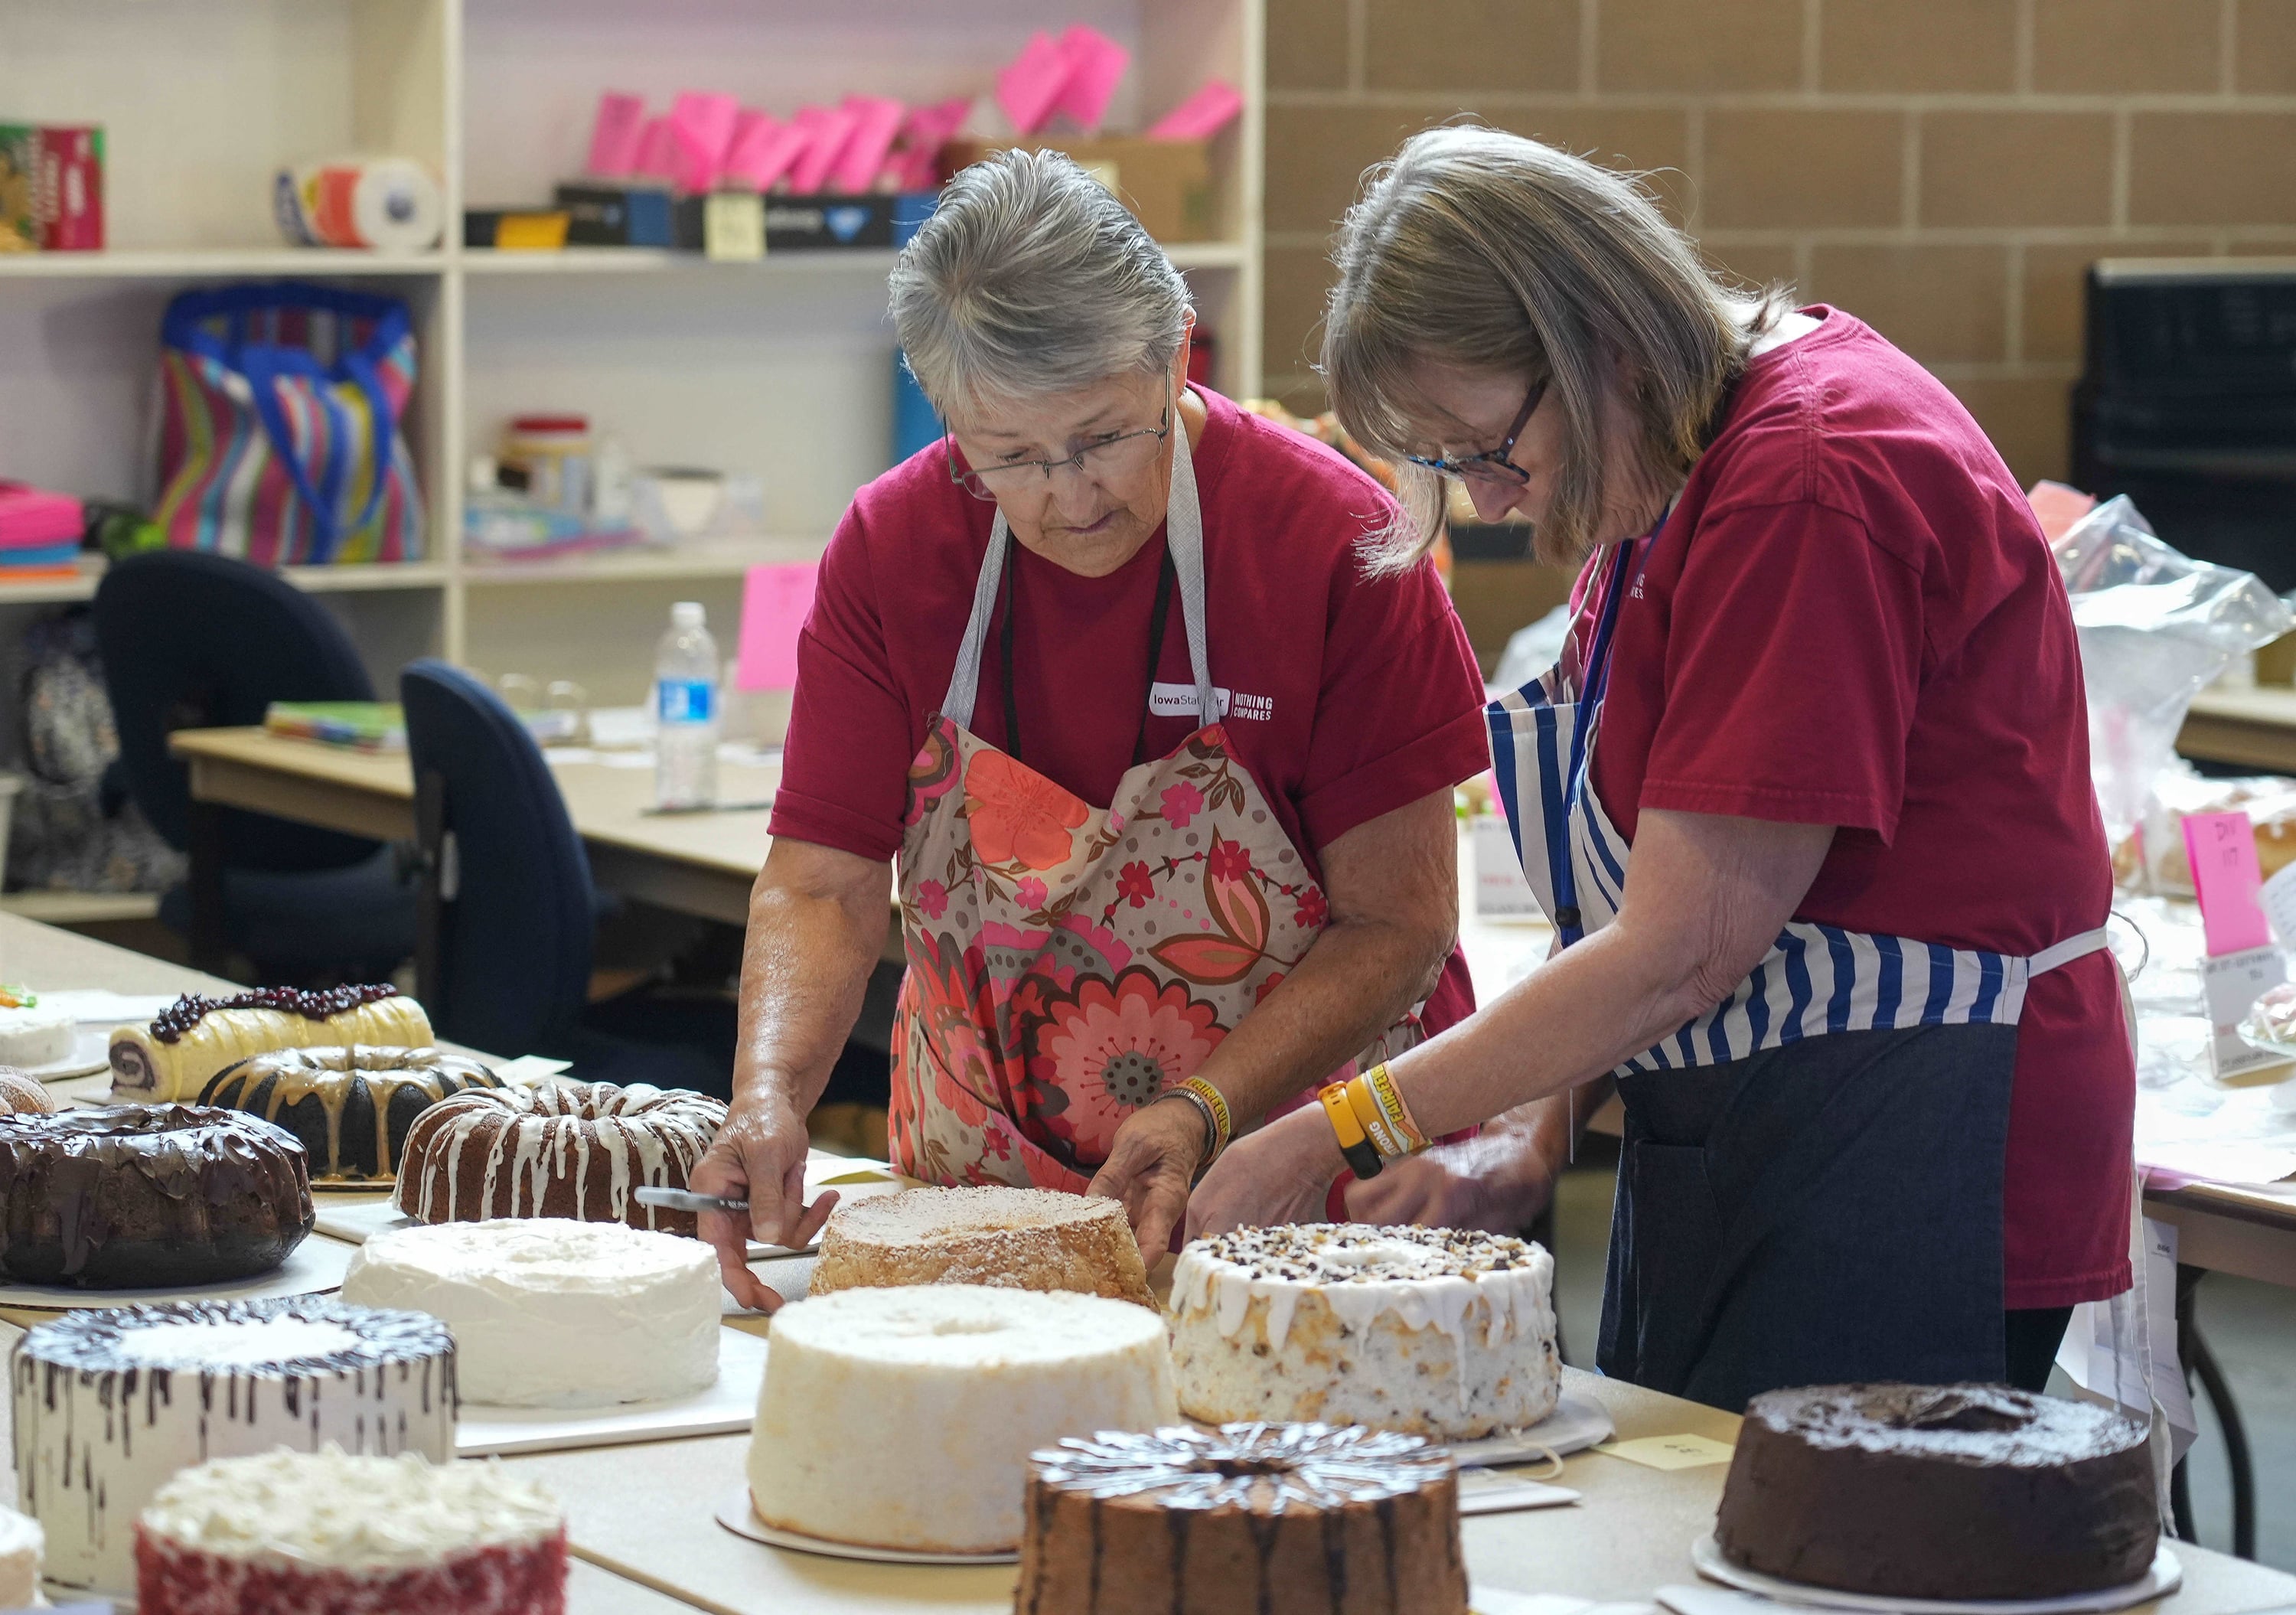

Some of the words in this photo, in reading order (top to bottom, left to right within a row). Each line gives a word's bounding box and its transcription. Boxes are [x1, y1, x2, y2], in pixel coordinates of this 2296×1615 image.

[1234, 706, 1271, 721] COMPARES
[1235, 693, 1273, 710] NOTHING
[1186, 1078, 1216, 1101] FAIR
[1209, 1095, 1229, 1134] FEVER
[1380, 1088, 1406, 1124] FAIR
